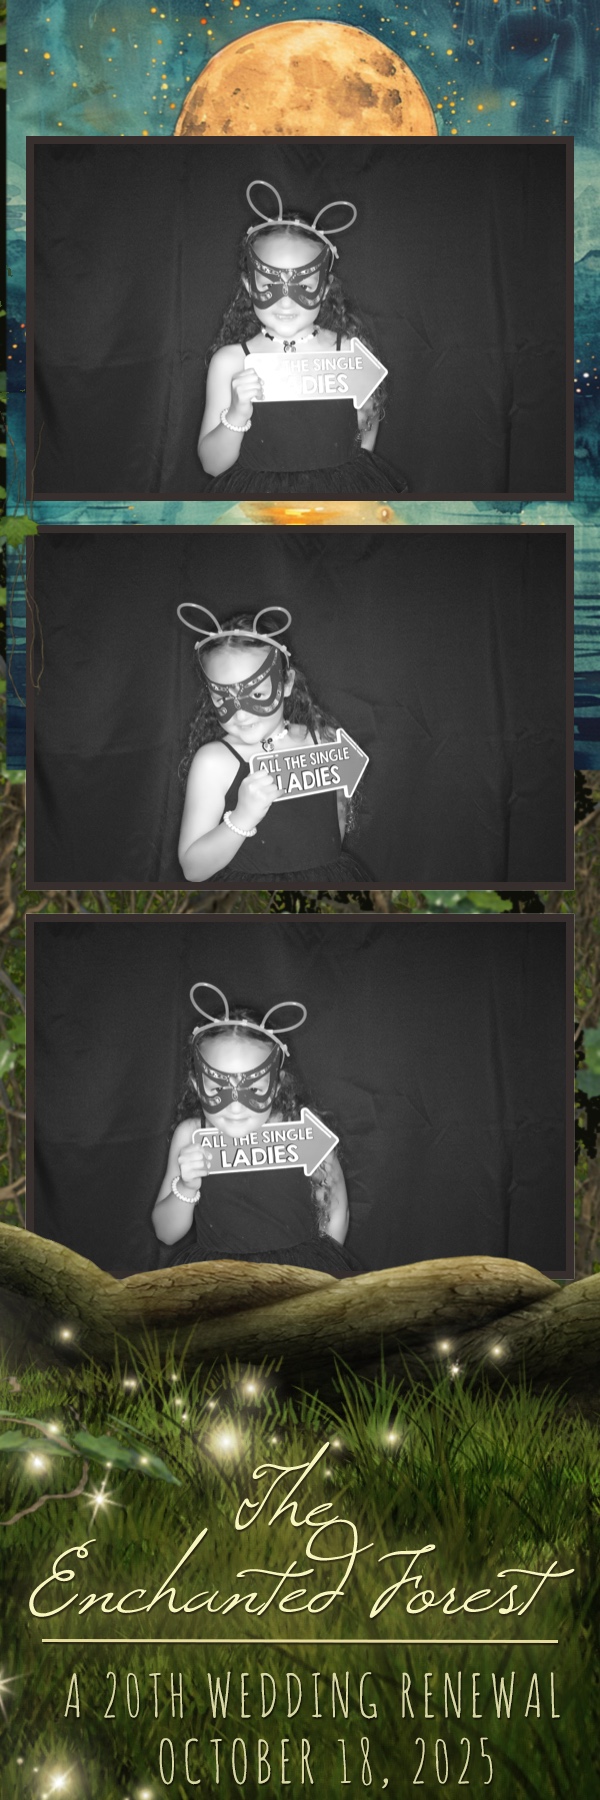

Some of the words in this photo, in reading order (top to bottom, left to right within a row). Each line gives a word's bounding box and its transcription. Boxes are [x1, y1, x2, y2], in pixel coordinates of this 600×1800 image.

[313, 357, 363, 371] SINGLE
[259, 759, 282, 774] ALL
[284, 754, 308, 770] THE
[310, 747, 350, 766] SINGLE
[276, 765, 341, 793] LADIES
[201, 1135, 227, 1148] ALL
[262, 1127, 313, 1144] SINGLE
[221, 1144, 299, 1168] LADIES
